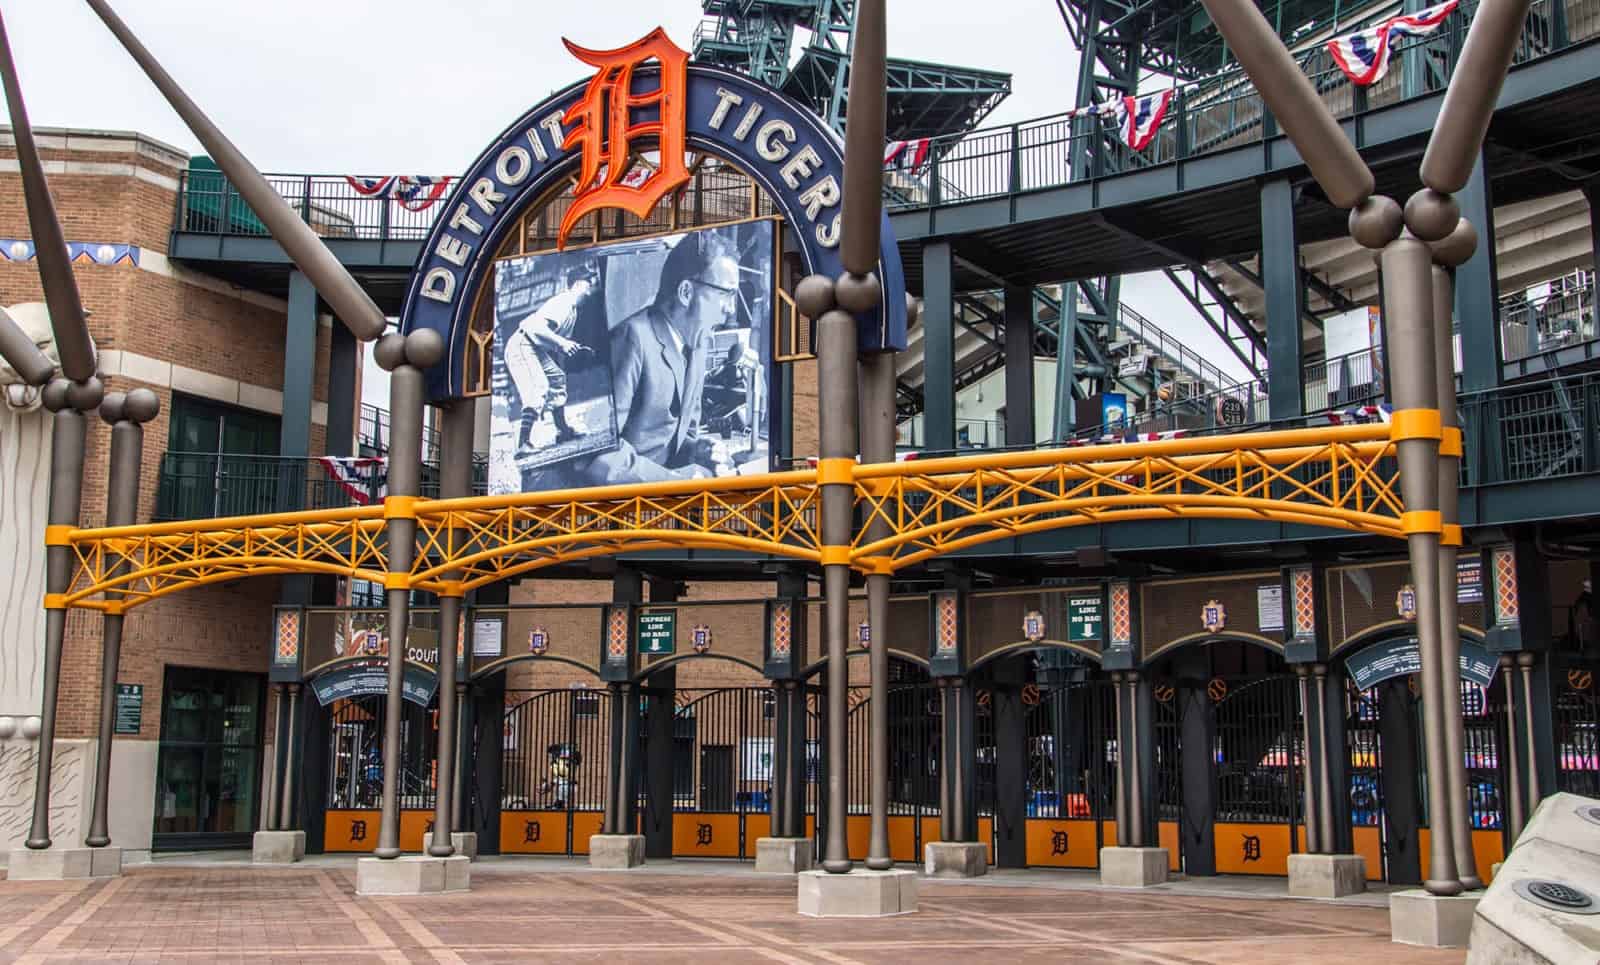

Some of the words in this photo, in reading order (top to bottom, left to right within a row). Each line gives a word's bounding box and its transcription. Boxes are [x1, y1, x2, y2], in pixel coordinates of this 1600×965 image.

[420, 110, 565, 303] DETROIT
[557, 26, 692, 251] D
[708, 87, 841, 248] TIGERS
